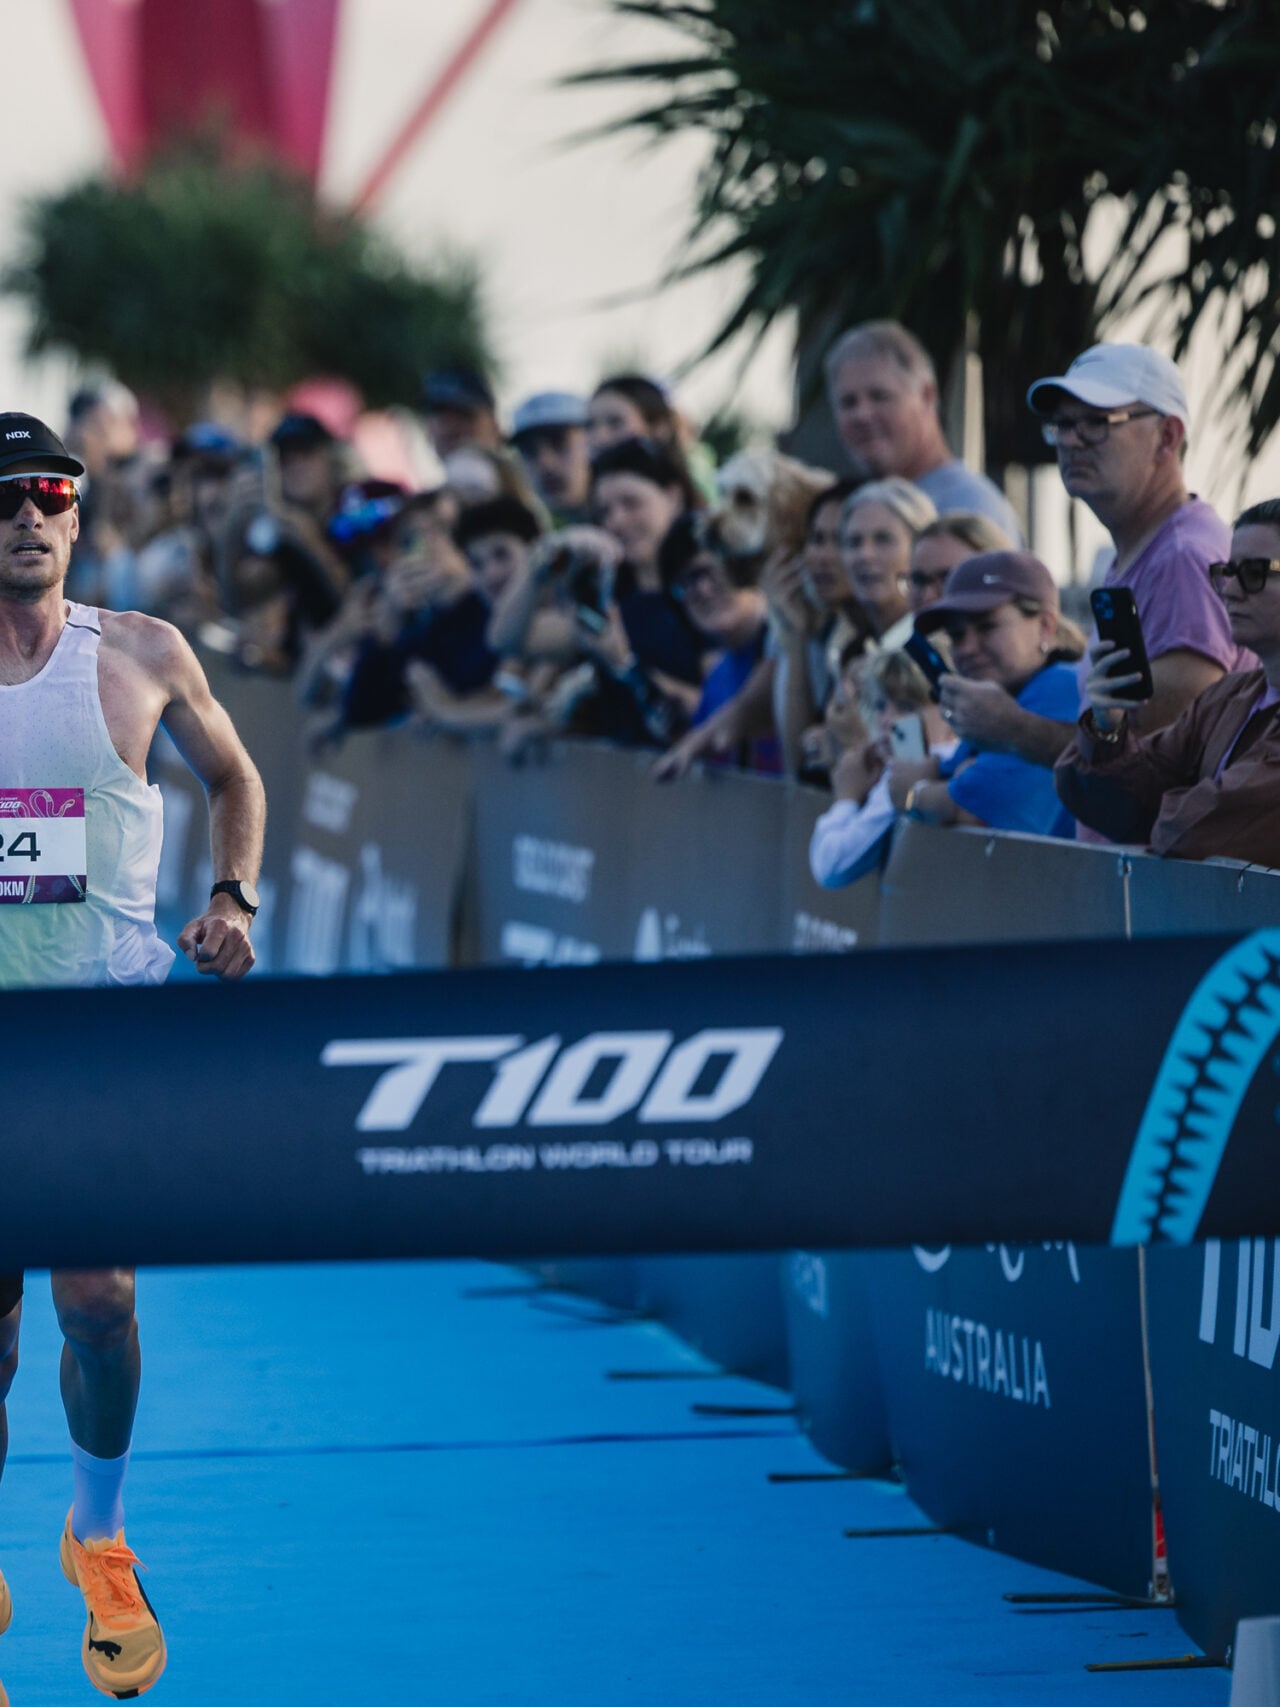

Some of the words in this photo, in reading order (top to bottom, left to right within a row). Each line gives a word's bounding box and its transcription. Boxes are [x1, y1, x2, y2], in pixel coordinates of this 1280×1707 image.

[6, 431, 31, 440] NOX
[322, 1026, 784, 1131] T100
[357, 1144, 535, 1174] TRIATHLON
[541, 1139, 658, 1168] WORLD
[663, 1137, 753, 1165] TOUR
[926, 1307, 1050, 1408] AUSTRALIA
